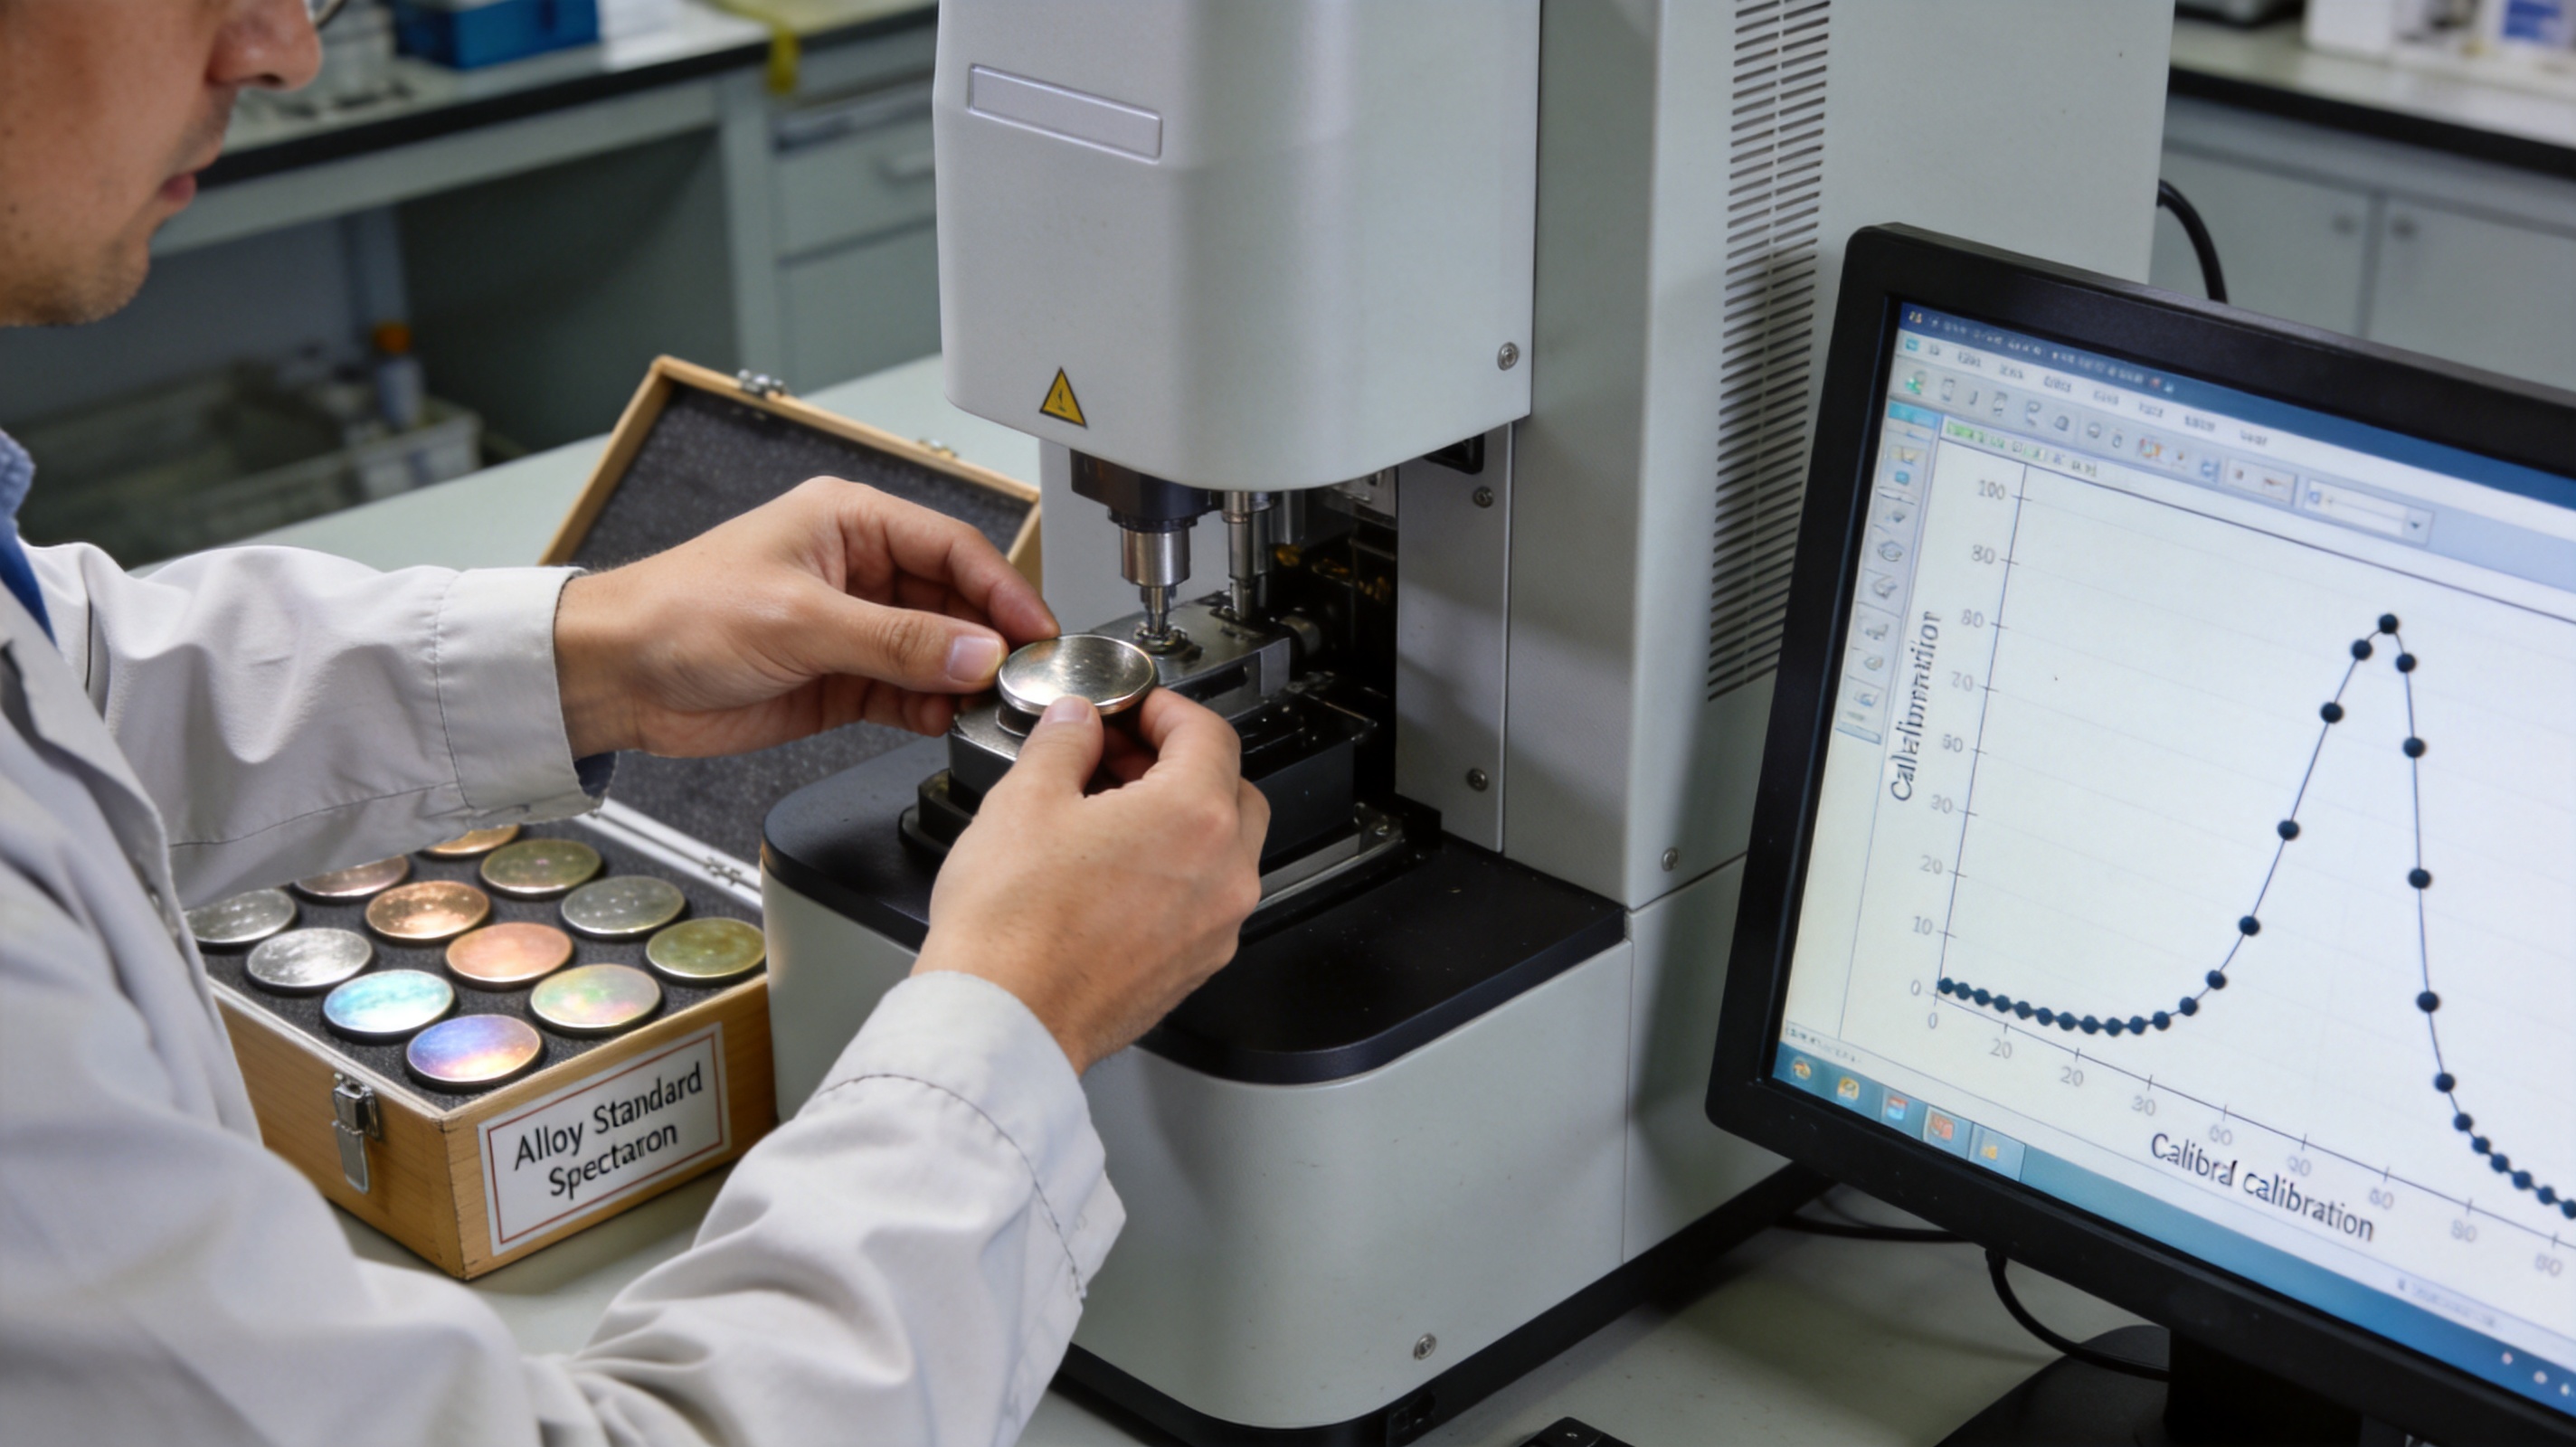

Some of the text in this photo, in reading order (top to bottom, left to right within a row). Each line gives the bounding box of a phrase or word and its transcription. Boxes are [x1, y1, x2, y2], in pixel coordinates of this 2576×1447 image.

[1919, 855, 1943, 875] 20
[1913, 915, 1933, 936] 10
[1910, 979, 1922, 997] 0
[1927, 1012, 1938, 1030] 0
[1989, 1038, 2012, 1060] 20
[2060, 1065, 2084, 1087] 20
[514, 1060, 704, 1171] Alloy Standard
[548, 1123, 678, 1201] Spectaron
[2242, 1172, 2374, 1243] calibration
